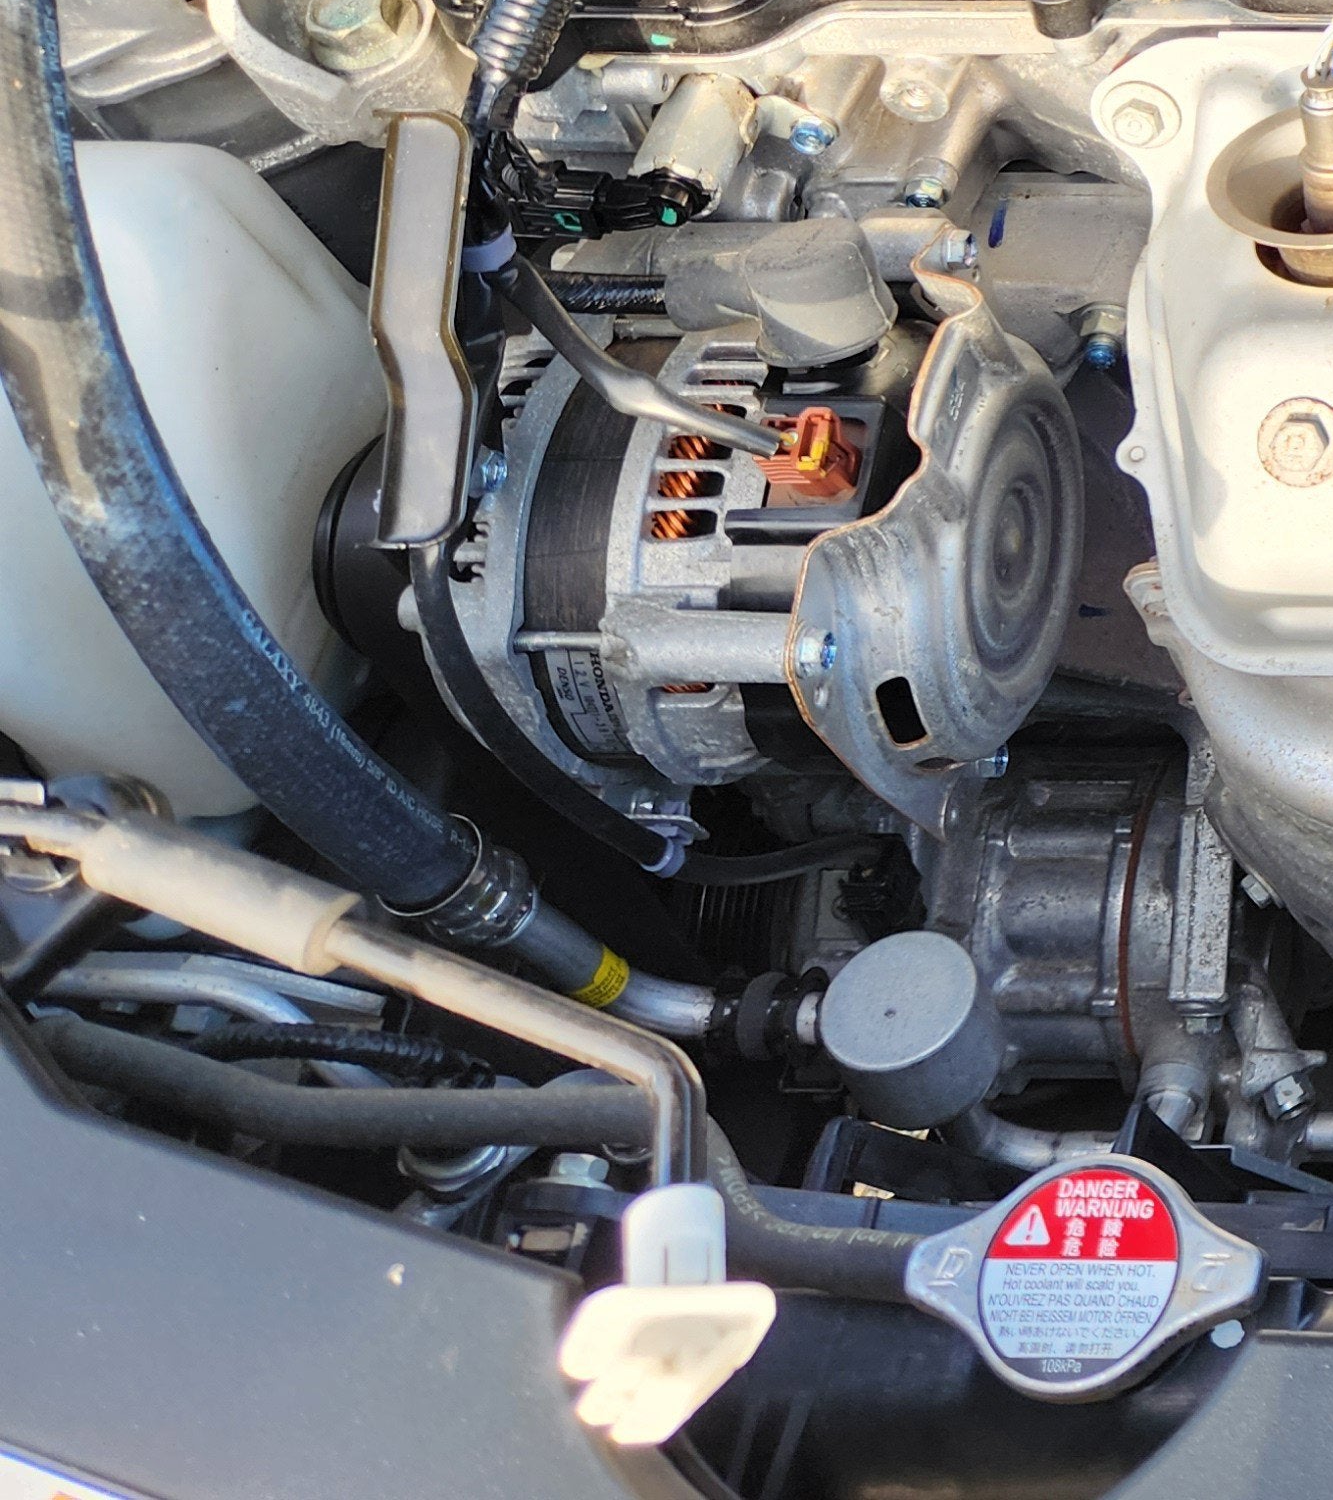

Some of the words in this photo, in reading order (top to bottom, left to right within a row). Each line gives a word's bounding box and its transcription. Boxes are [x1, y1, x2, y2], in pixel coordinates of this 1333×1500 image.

[238, 608, 304, 690] GALAXY
[302, 693, 331, 729] 4843
[556, 666, 575, 702] DENSO
[590, 651, 614, 713] HONDA
[1058, 1179, 1140, 1200] DANGER
[1055, 1198, 1155, 1219] WARNUNG
[1005, 1264, 1047, 1276] NEVER
[1050, 1264, 1085, 1276] OPEN
[1087, 1264, 1125, 1276] WHEN
[1127, 1264, 1157, 1277] HOT.
[1002, 1279, 1022, 1291] Hot
[1024, 1279, 1064, 1291] coolant
[1066, 1279, 1085, 1291] will
[1086, 1279, 1115, 1291] scald
[1117, 1281, 1141, 1294] you.
[988, 1294, 1045, 1307] N'OUVREZ
[1048, 1294, 1071, 1306] PAS
[1074, 1294, 1116, 1307] QUAND
[1118, 1295, 1162, 1308] CHAUD.
[989, 1310, 1018, 1322] NICHT
[1019, 1310, 1035, 1322] BEI
[1036, 1310, 1076, 1322] HEISSEM
[1078, 1310, 1111, 1322] MOTOR
[1041, 1359, 1083, 1375] 108kPa
